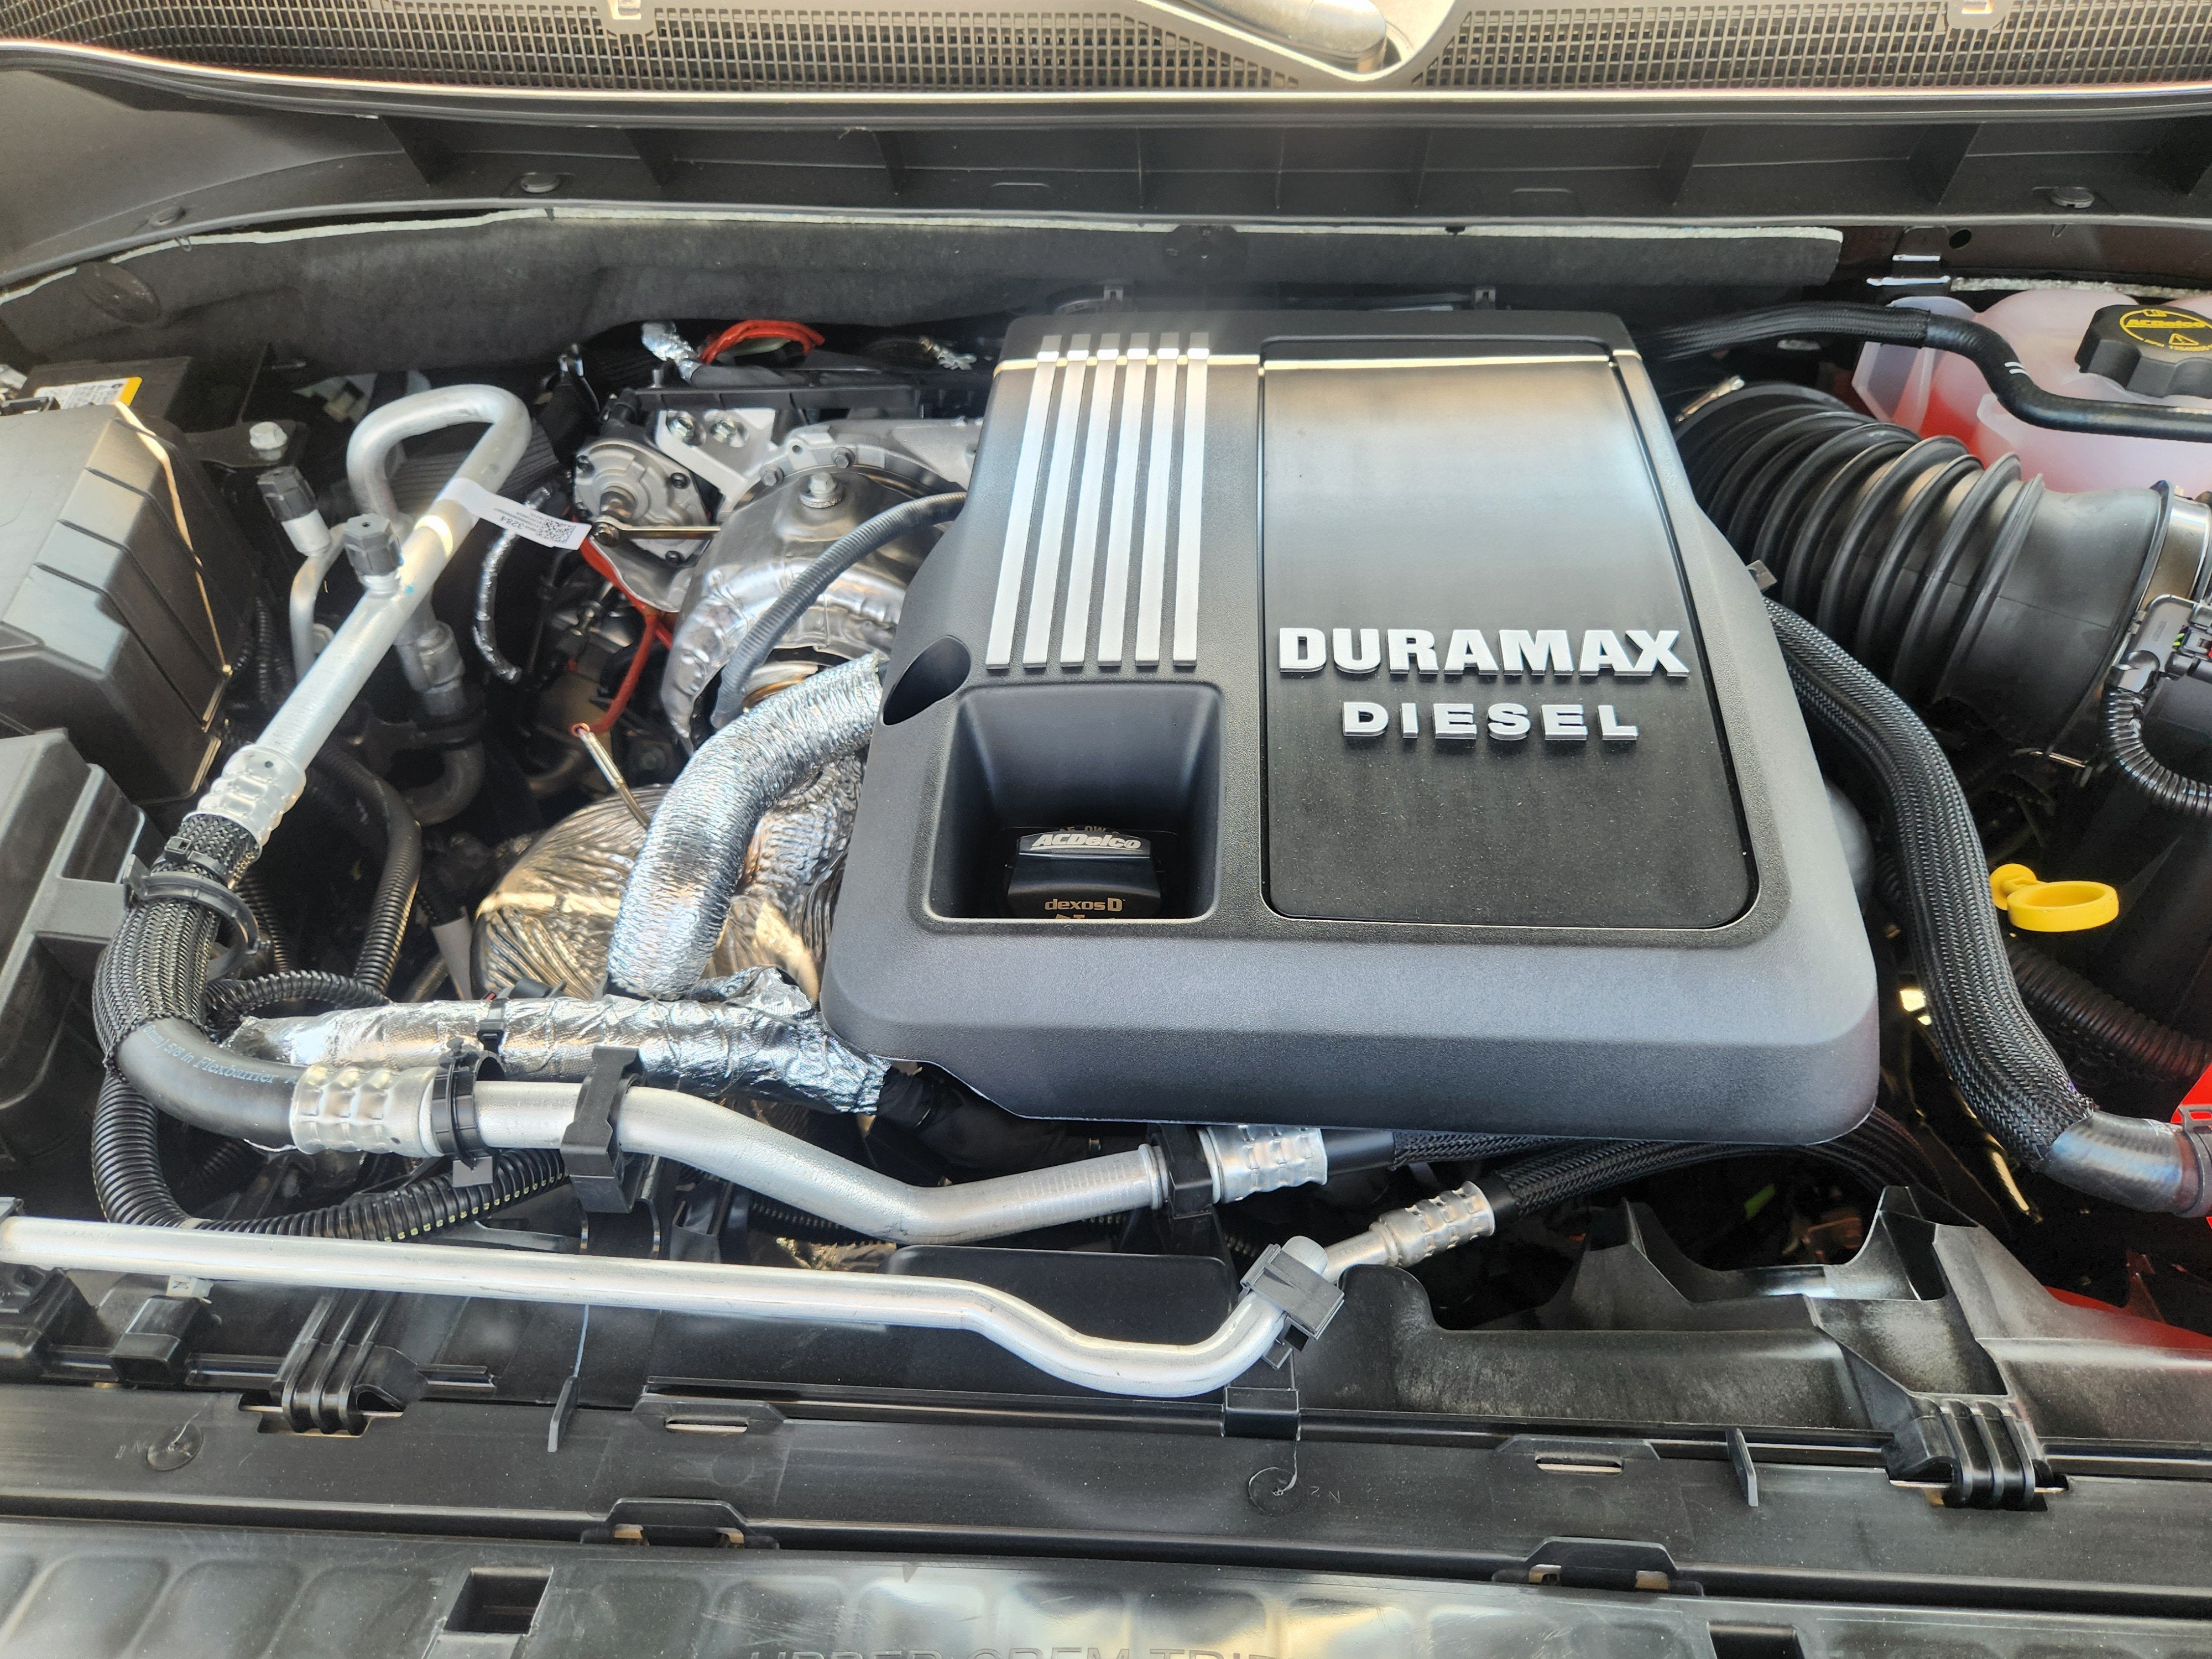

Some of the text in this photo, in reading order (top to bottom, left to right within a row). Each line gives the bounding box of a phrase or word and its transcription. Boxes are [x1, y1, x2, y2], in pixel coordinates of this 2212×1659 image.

[1279, 628, 1690, 677] DURAMAX
[1342, 702, 1639, 740] DIESEL
[1032, 833, 1141, 849] ACDelco
[181, 1052, 195, 1063] in
[193, 1056, 279, 1083] Flexbarrier
